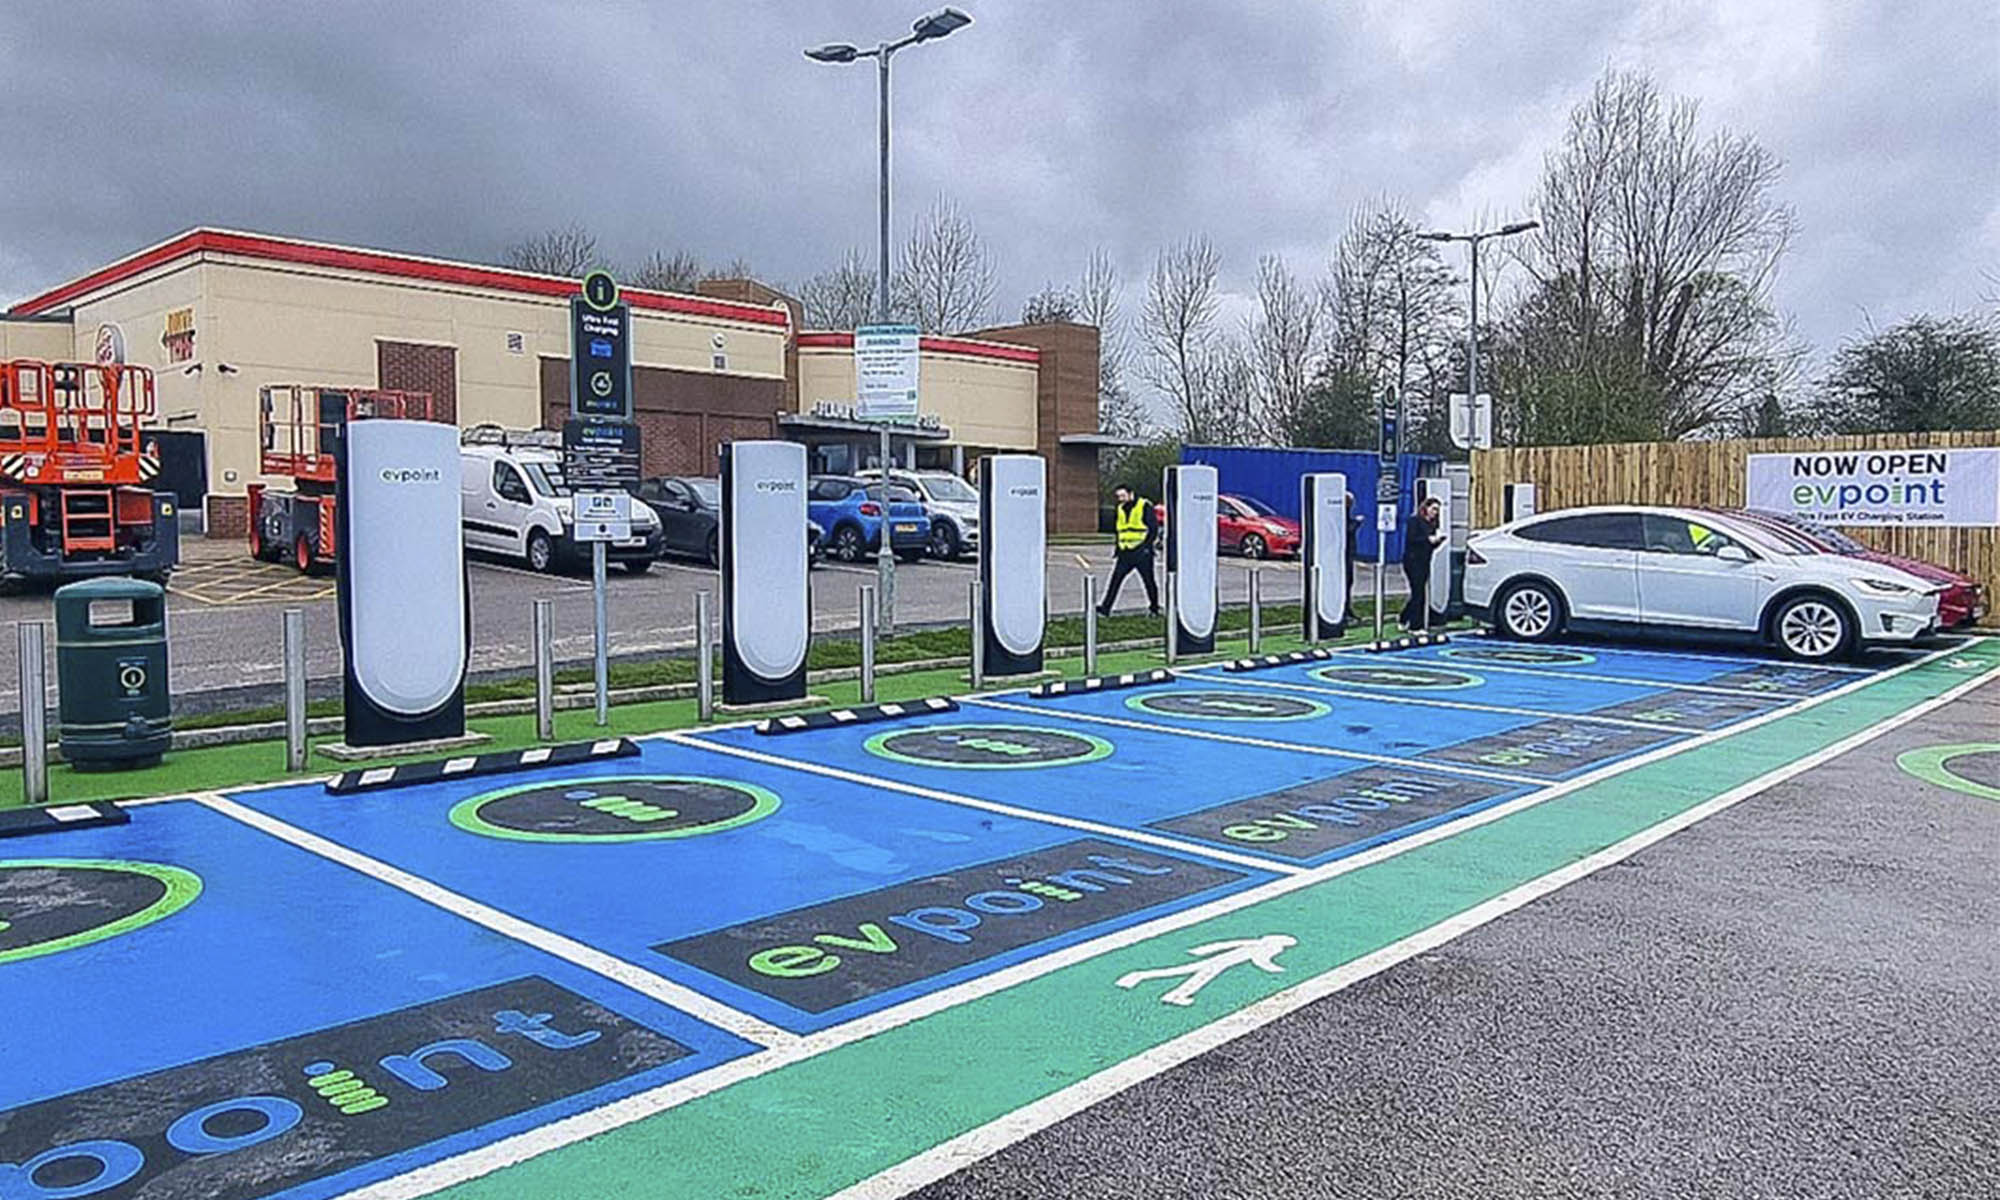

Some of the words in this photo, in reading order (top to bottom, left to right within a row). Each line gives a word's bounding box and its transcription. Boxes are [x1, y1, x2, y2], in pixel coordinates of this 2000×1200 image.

[382, 469, 440, 483] evpoint
[1793, 455, 1858, 477] NOW
[1867, 453, 1946, 475] OPEN
[1793, 477, 1945, 509] evpoint
[1840, 511, 1855, 520] EV
[1857, 511, 1904, 523] Charging
[1906, 511, 1945, 521] Station
[1222, 776, 1459, 843] evpoint
[747, 854, 1173, 980] evpoint
